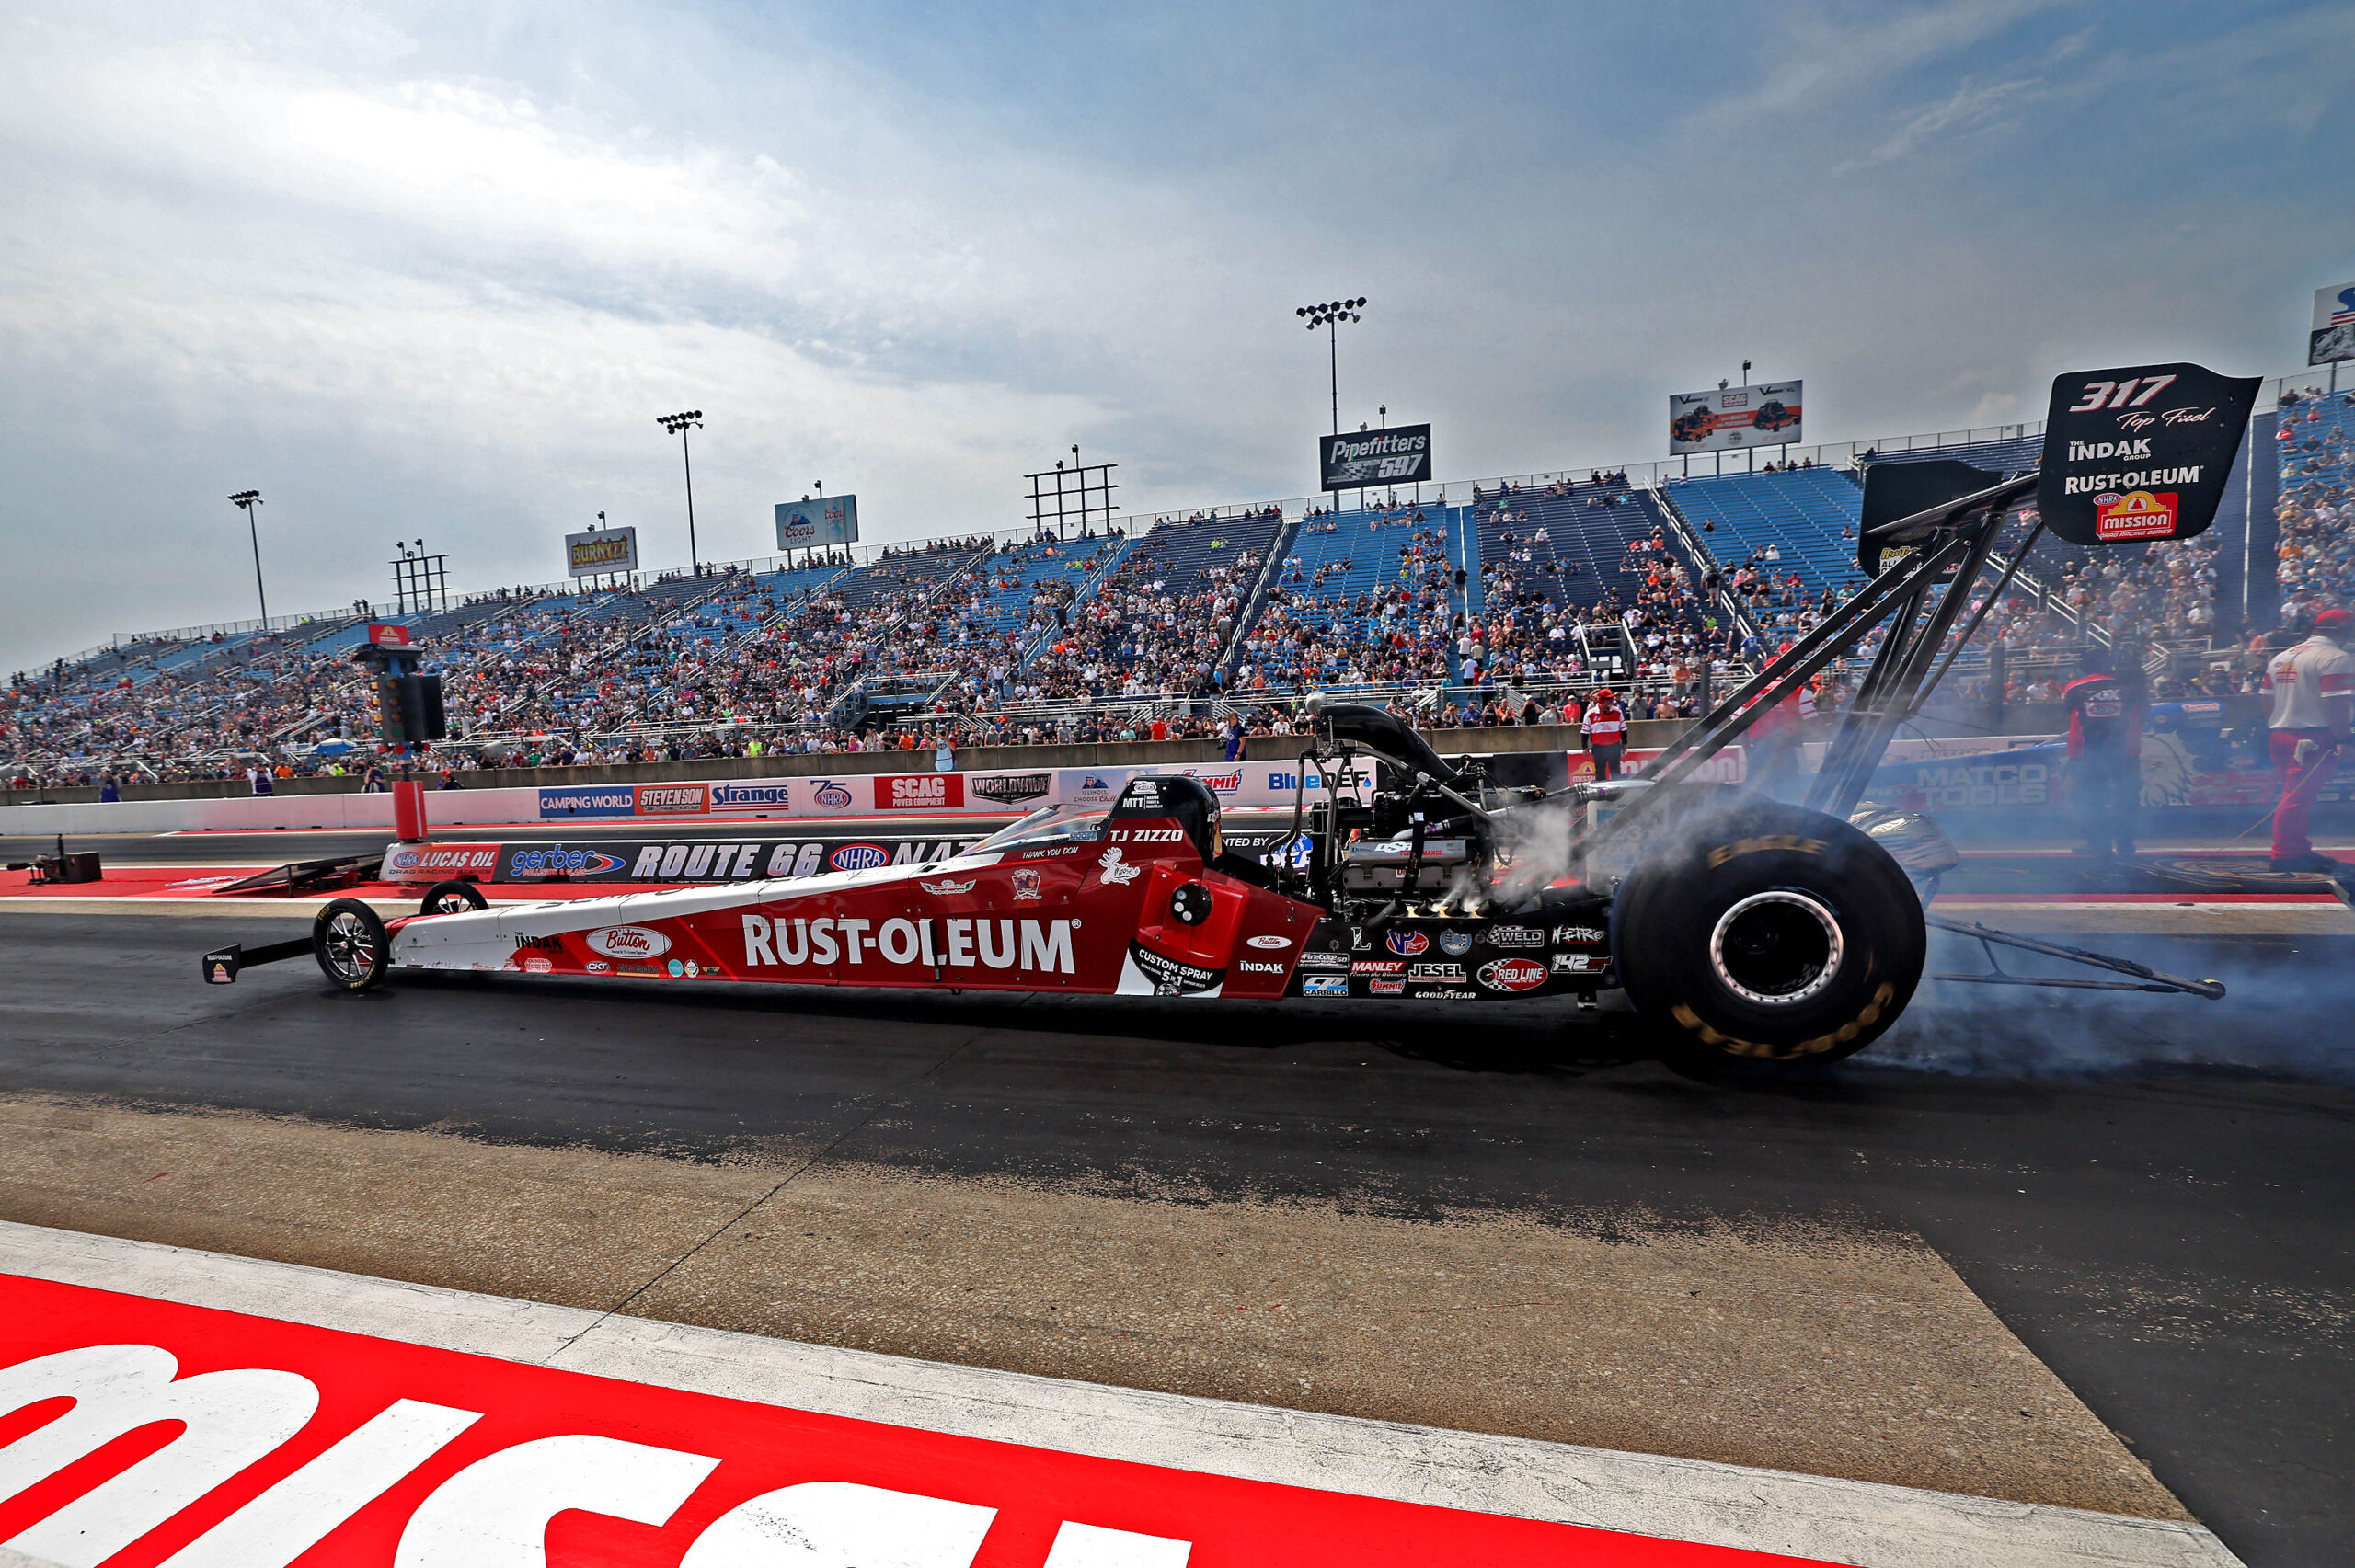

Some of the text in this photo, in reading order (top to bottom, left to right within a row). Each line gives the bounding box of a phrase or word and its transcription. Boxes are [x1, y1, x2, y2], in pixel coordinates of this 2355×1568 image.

[2069, 374, 2177, 412] 317
[2116, 407, 2216, 432] Top Fuel
[1330, 434, 1426, 464] Pipefitters
[2068, 438, 2152, 462] INDAK
[1377, 454, 1424, 478] 597
[2065, 465, 2200, 495] RUST-OLEUM
[2098, 495, 2119, 504] NHRA
[785, 525, 816, 538] Coors
[790, 536, 811, 544] LIGHT
[1917, 764, 2048, 786] MATCO
[891, 777, 945, 798] SCAG
[973, 777, 1049, 794] WORLDWIDE
[541, 795, 591, 809] CAMPING
[593, 795, 633, 808] WORLD
[640, 788, 704, 806] STEVENSON
[711, 784, 788, 805] Strange
[820, 793, 844, 805] NHRA
[892, 797, 945, 807] POWER EQUIPMENT
[1122, 797, 1143, 807] MTT
[1917, 784, 2047, 807] TOOLS
[1110, 830, 1184, 841] TJ ZIZZO
[1252, 838, 1269, 846] BY
[396, 851, 497, 867] NHRA LUCAS OIL
[1047, 849, 1062, 857] YOU
[1063, 846, 1079, 854] DON
[511, 844, 596, 876] gerber
[631, 844, 762, 877] ROUTE
[767, 843, 824, 876] 66
[838, 847, 880, 870] NHRA
[515, 935, 563, 950] INDAK
[605, 930, 650, 951] Button
[1387, 928, 1417, 955] VP
[1500, 932, 1542, 941] WELD
[588, 962, 608, 971] CKT
[1139, 949, 1213, 981] CUSTOM SPRAY
[1240, 963, 1283, 972] INDAK
[1351, 962, 1403, 971] MANLEY
[1408, 963, 1466, 978] JESEL
[1161, 971, 1171, 981] 5
[1177, 976, 1183, 986] 1
[1498, 968, 1544, 979] RED LINE
[1415, 990, 1476, 999] GOODYEAR
